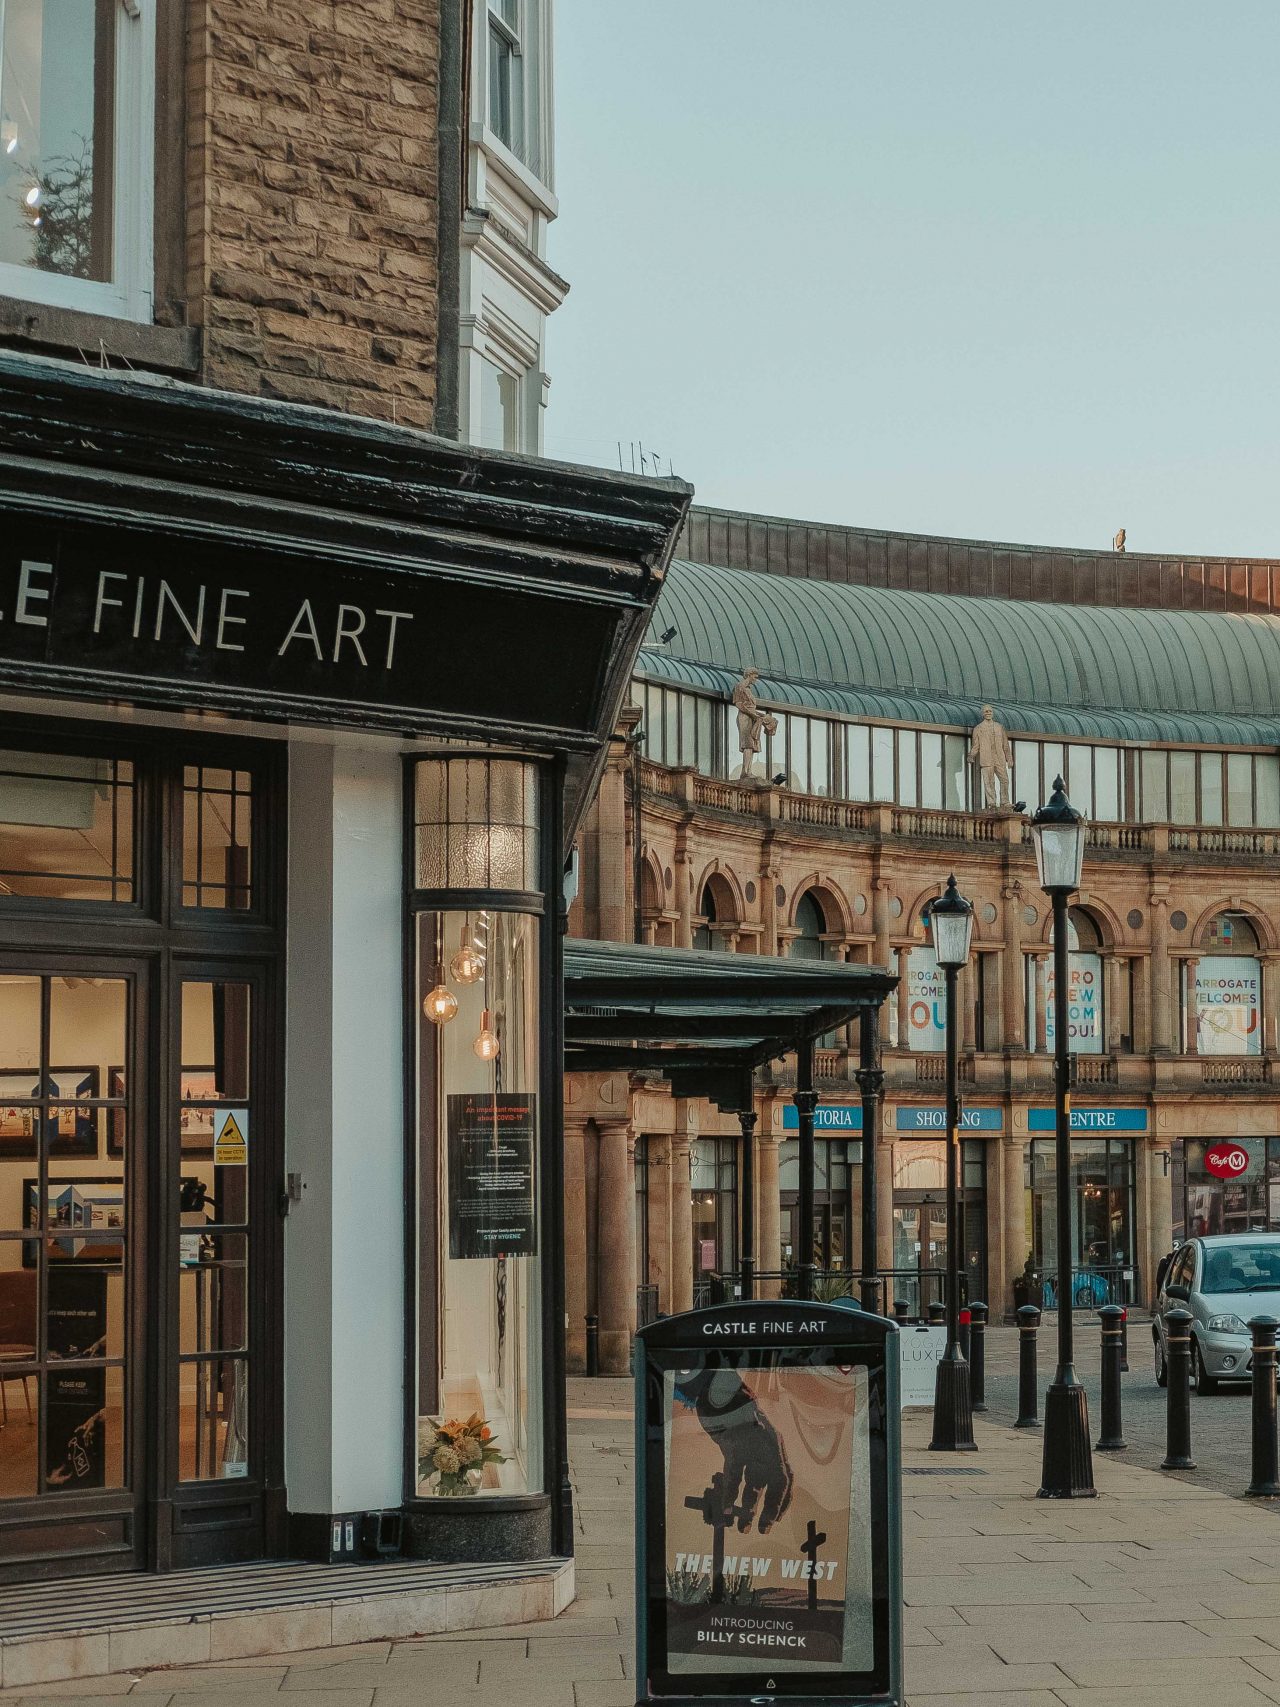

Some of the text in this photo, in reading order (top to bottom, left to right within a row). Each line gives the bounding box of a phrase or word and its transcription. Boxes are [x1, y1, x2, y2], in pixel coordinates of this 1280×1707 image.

[0, 560, 414, 670] E FINE ART
[1195, 979, 1257, 989] ARROGATE
[910, 1001, 946, 1029] OU
[813, 1111, 852, 1125] CTORIA
[916, 1111, 980, 1126] SHONG
[1069, 1112, 1116, 1126] ENTRE
[702, 1320, 828, 1335] CASTLE FINE ART
[902, 1337, 945, 1349] YOGA
[902, 1349, 943, 1361] LUXE
[675, 1553, 838, 1581] THE NEW WEST
[711, 1617, 794, 1631] INTRODUCING
[697, 1631, 807, 1648] BILLY SCHENCK
